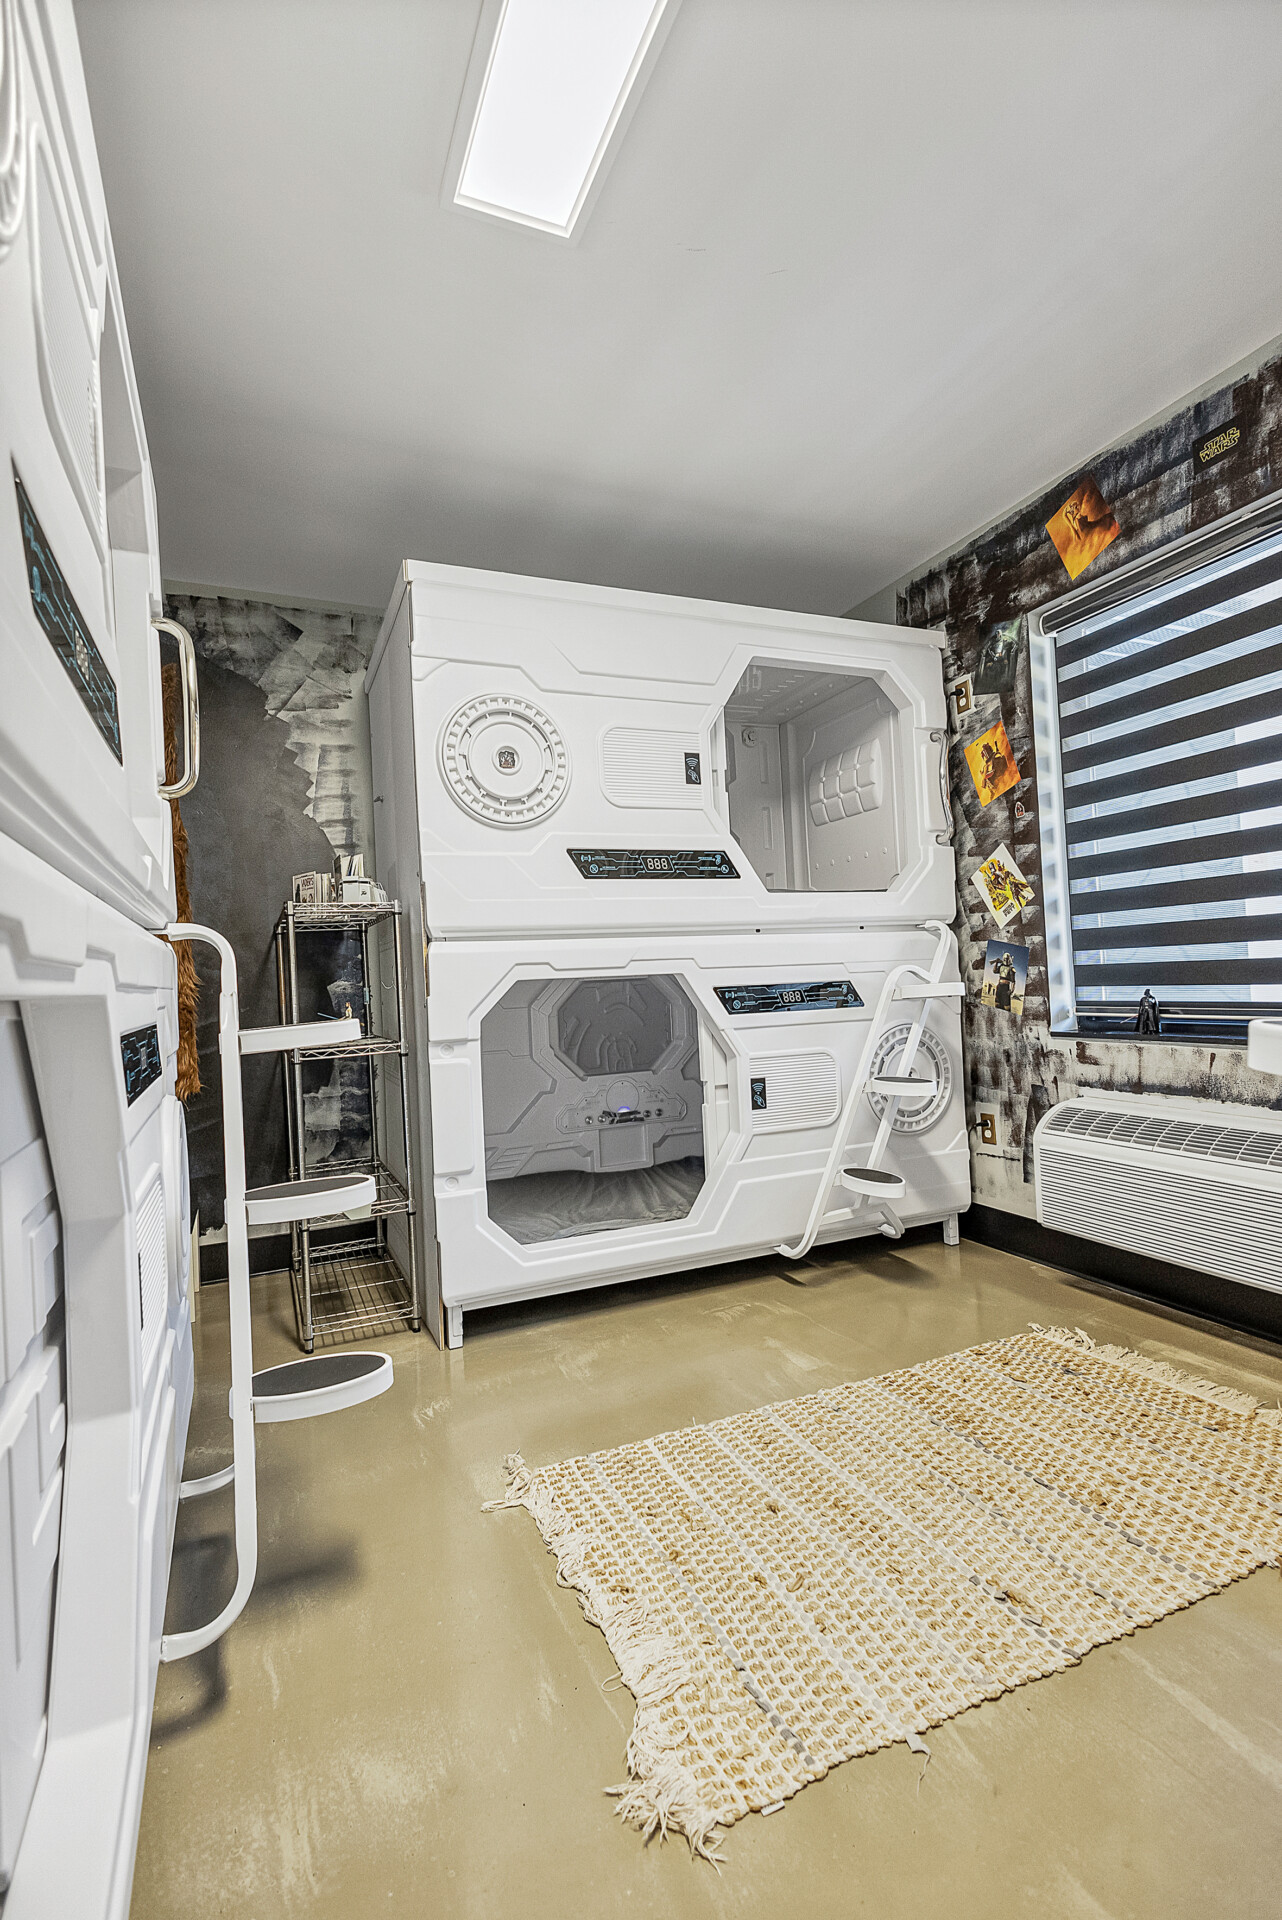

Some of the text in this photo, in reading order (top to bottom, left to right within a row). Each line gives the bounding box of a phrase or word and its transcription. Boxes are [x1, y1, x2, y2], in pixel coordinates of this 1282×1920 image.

[1204, 427, 1240, 450] STAR
[1200, 434, 1240, 462] WARS
[647, 858, 668, 870] 888
[782, 991, 802, 1003] 888
